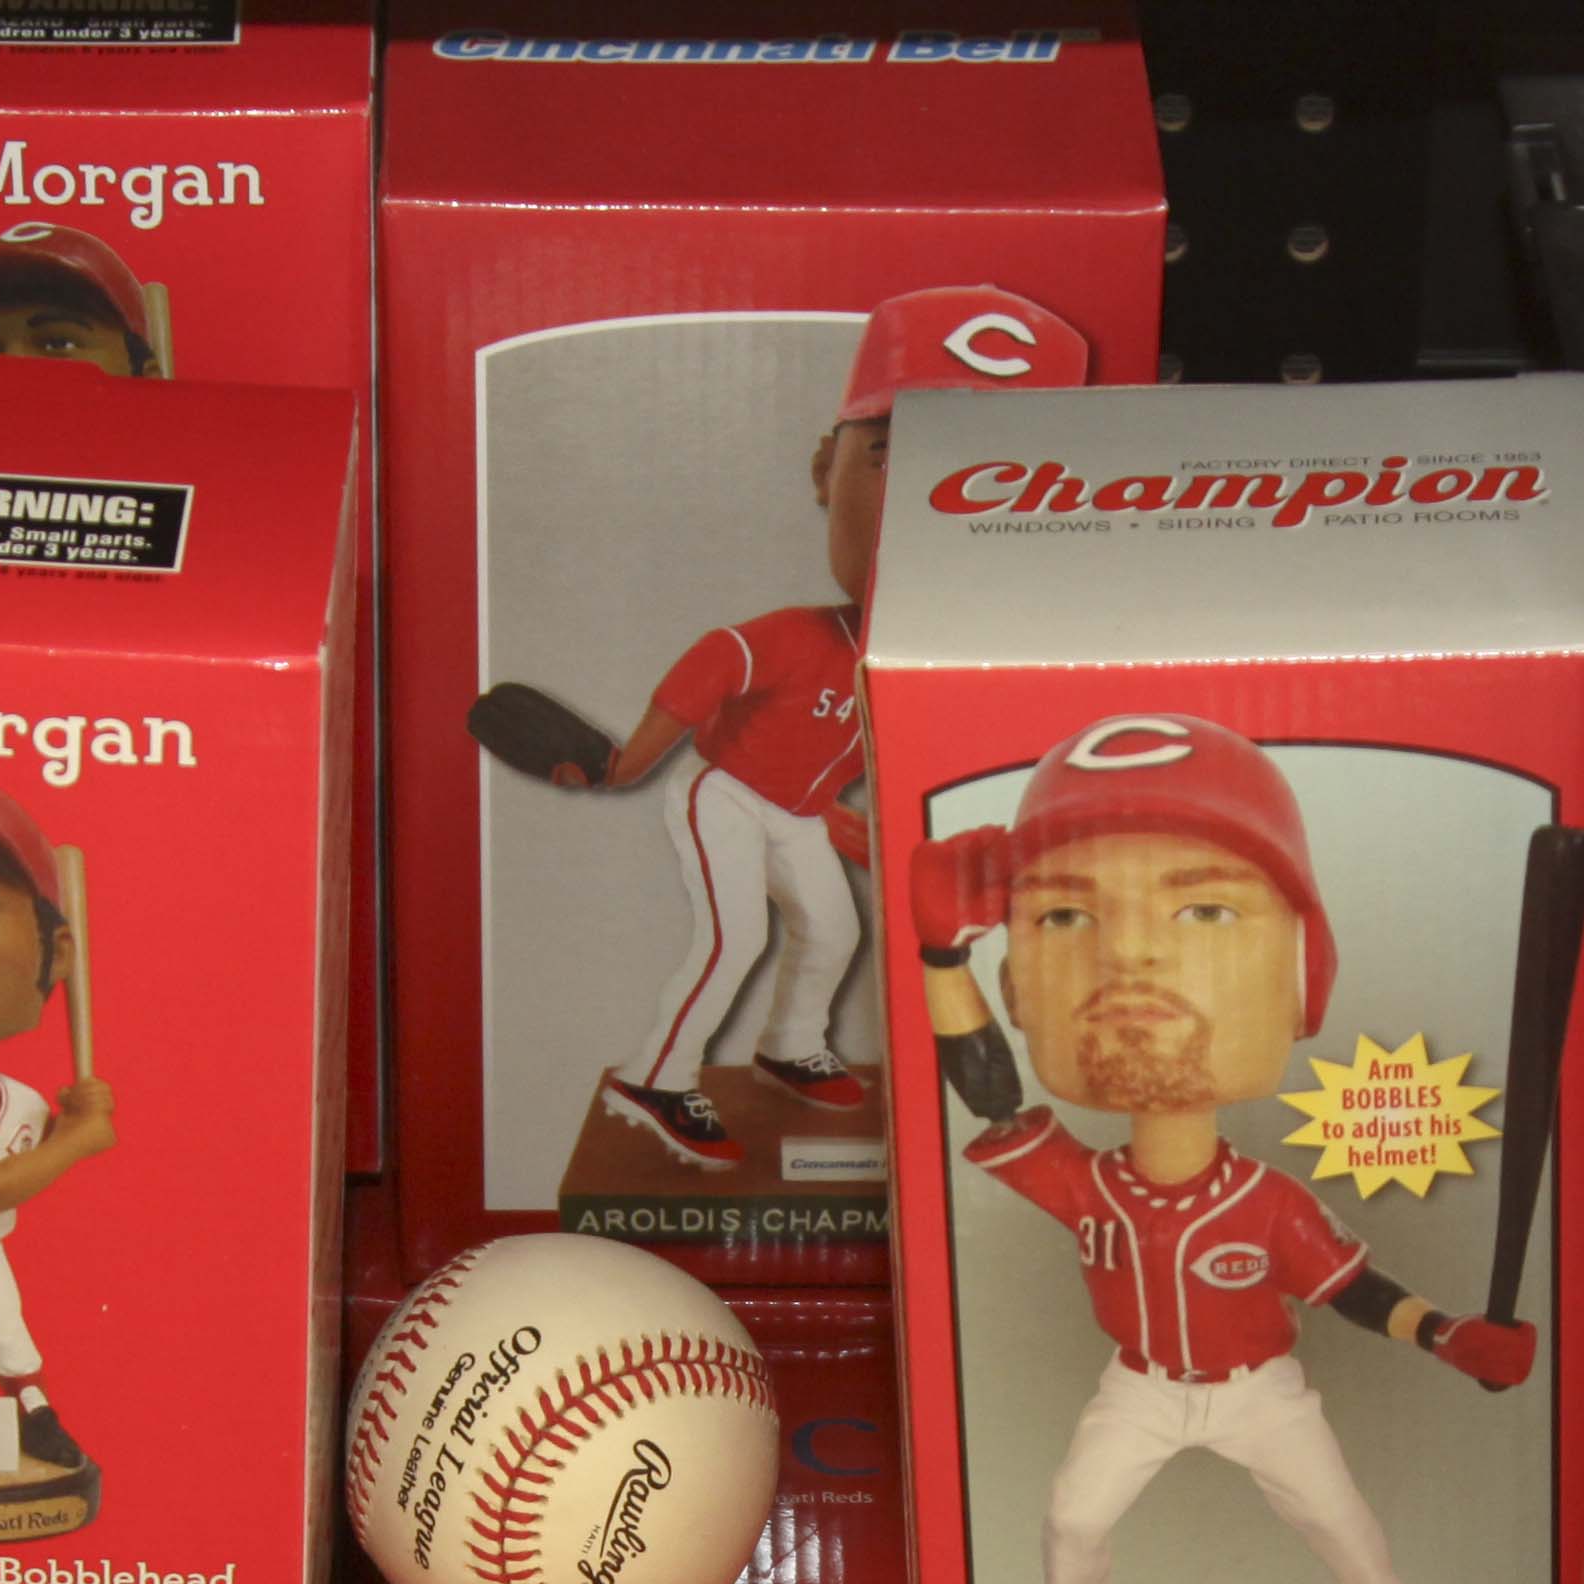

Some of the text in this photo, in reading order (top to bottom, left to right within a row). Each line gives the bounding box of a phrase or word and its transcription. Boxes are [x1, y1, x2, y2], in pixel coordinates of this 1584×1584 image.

[53, 26, 111, 39] under
[119, 27, 130, 38] 3
[432, 29, 1062, 62] Cincinnati Bell
[1181, 458, 1281, 471] FACTORY
[1289, 455, 1371, 469] DIRECT
[1417, 453, 1486, 466] SINCE
[928, 455, 1549, 528] Champion
[968, 509, 1521, 535] WINDOWS SIDING PATIO ROOMS
[10, 525, 77, 543] Small
[84, 529, 153, 549] parts.
[44, 541, 58, 557] 3
[66, 543, 140, 563] years.
[1368, 1058, 1414, 1081] Arm
[1341, 1085, 1443, 1110] BOBBLES
[1321, 1113, 1463, 1144] to adjust his
[1347, 1143, 1438, 1168] helmet!
[577, 1207, 889, 1233] AROLDIS CHAPM
[1079, 1215, 1116, 1271] 31
[1214, 1254, 1270, 1275] REDS
[396, 1352, 476, 1513] Genuine Leather
[414, 1325, 542, 1571] Official League
[821, 1490, 874, 1504] Reds
